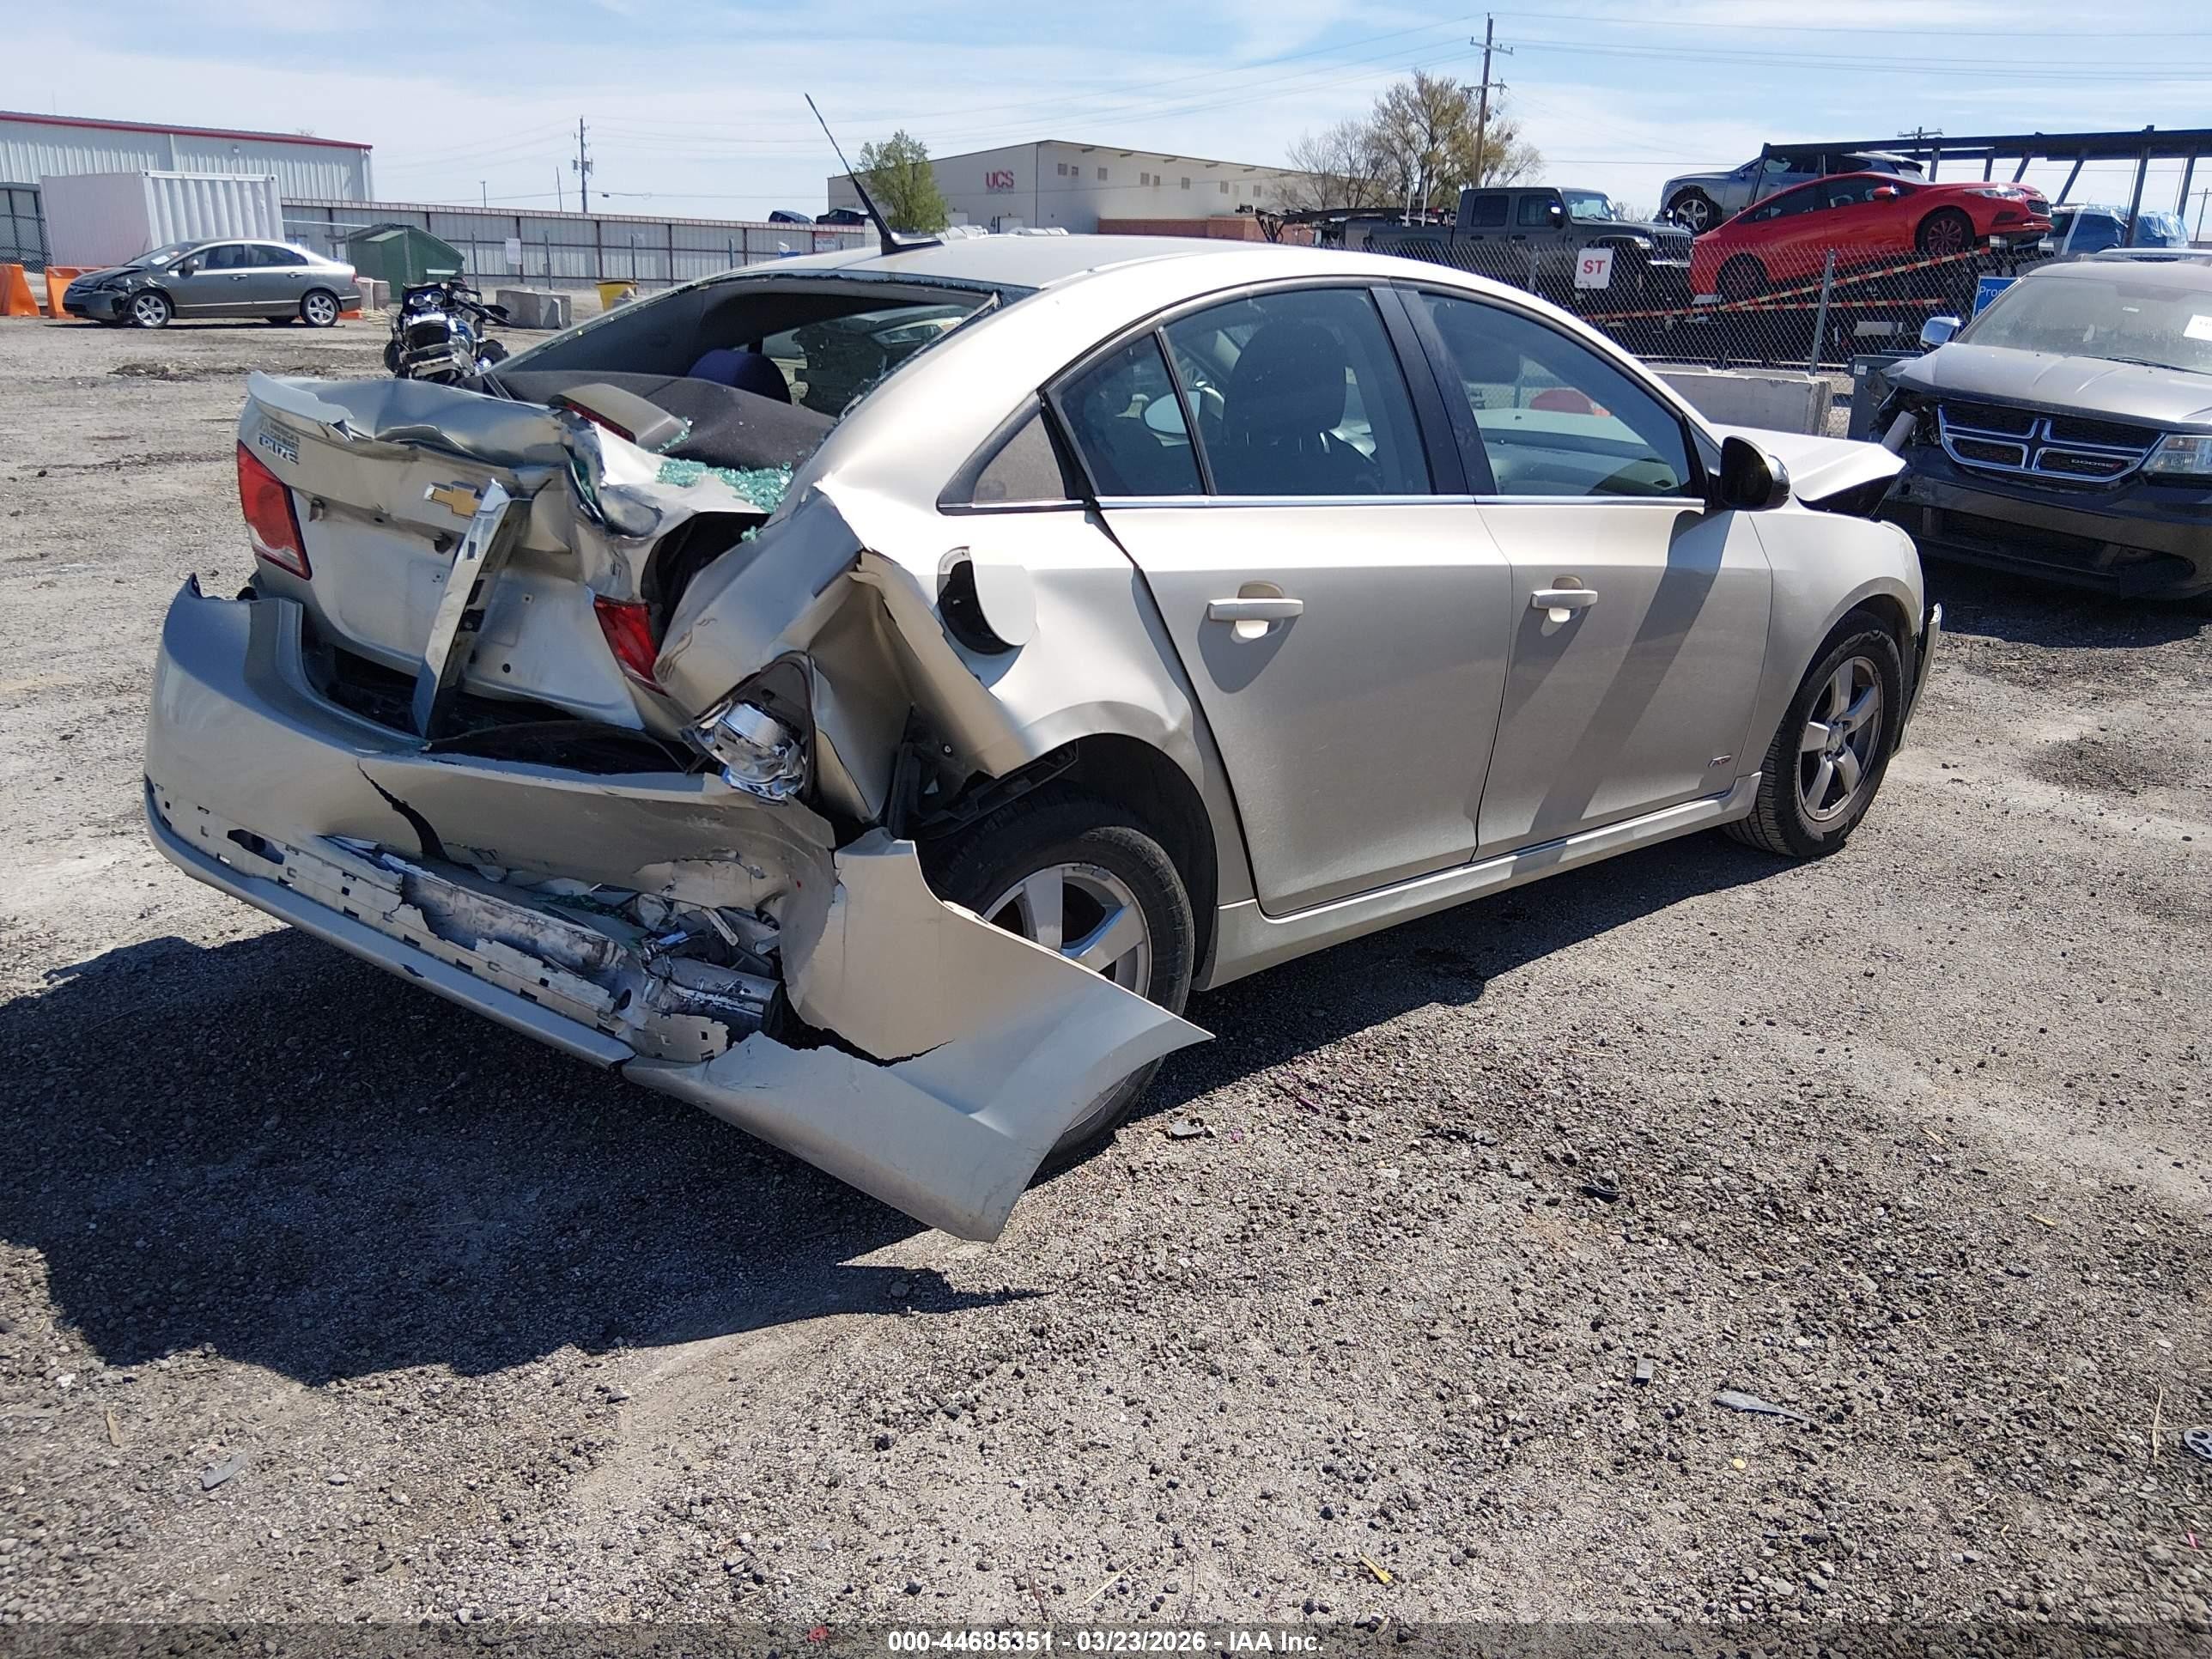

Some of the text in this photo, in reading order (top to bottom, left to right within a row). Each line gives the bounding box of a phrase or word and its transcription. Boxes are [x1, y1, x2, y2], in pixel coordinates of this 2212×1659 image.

[986, 171, 1014, 187] UCS
[1583, 259, 1606, 274] ST
[2071, 459, 2113, 467] DODGE
